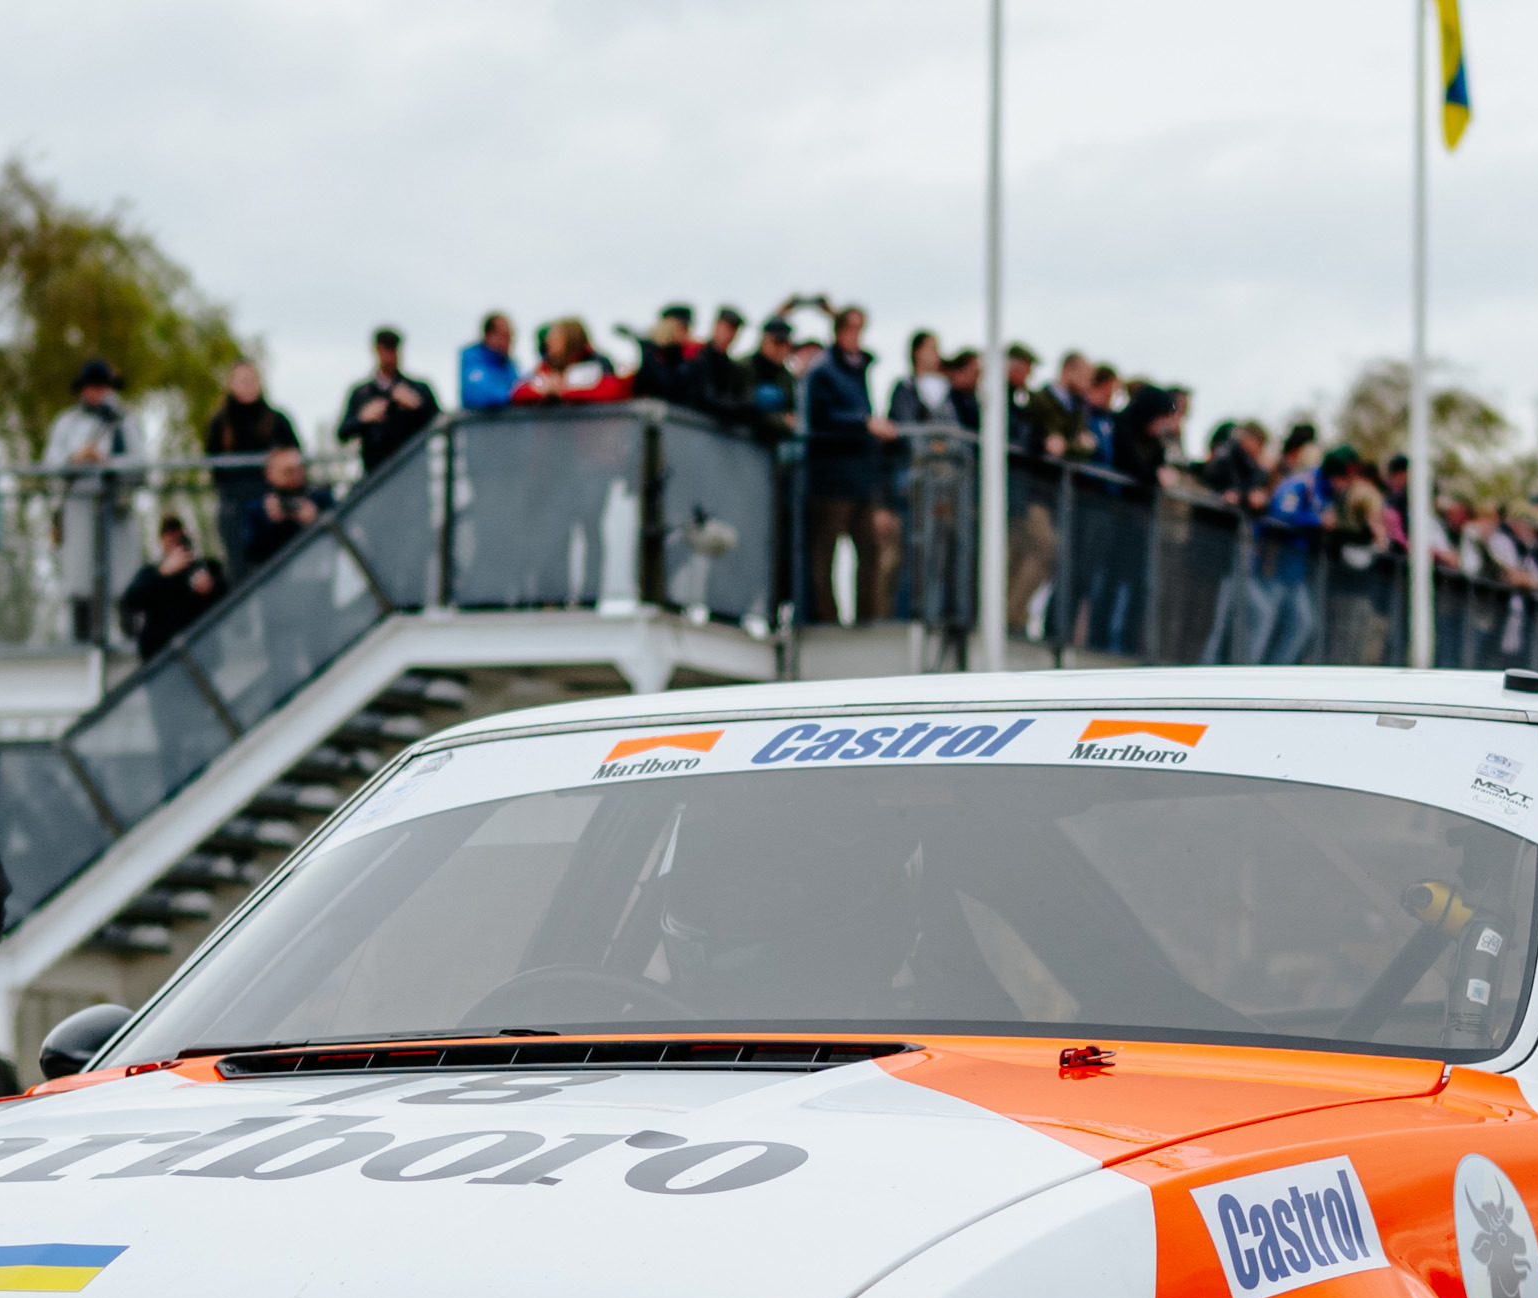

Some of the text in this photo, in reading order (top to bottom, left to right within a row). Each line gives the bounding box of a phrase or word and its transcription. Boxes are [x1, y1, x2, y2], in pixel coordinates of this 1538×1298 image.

[751, 719, 1036, 766] Castrol
[1068, 743, 1188, 764] Marlboro
[592, 754, 701, 781] Marlboro
[1474, 777, 1533, 802] MSVT
[289, 1073, 622, 1106] 18
[1217, 1169, 1371, 1290] Castrol
